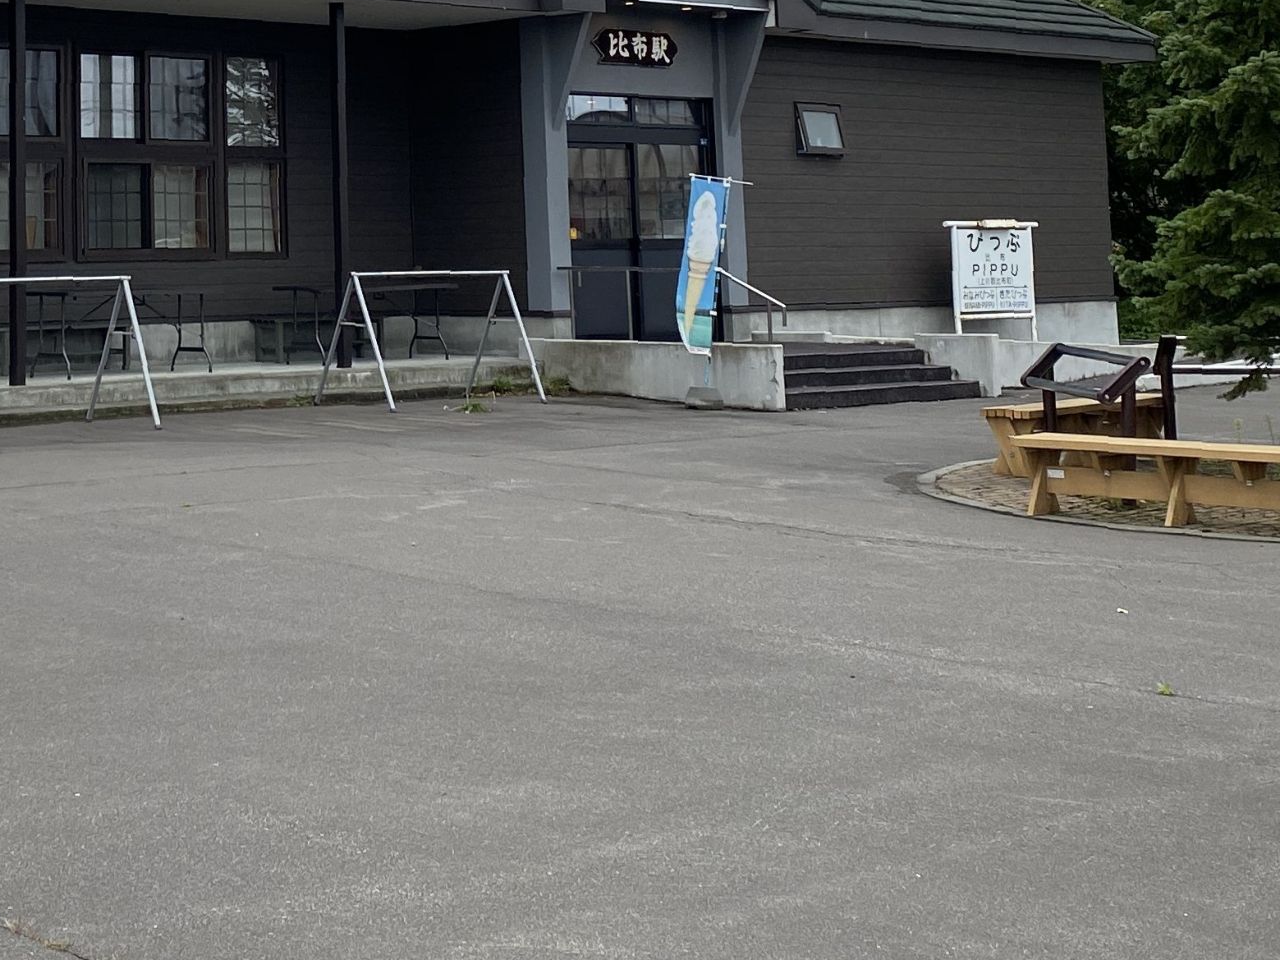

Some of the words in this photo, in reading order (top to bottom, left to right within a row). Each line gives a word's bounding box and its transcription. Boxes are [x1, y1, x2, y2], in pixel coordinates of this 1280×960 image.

[608, 31, 670, 63] 比布駅
[972, 264, 1018, 276] PIPPU
